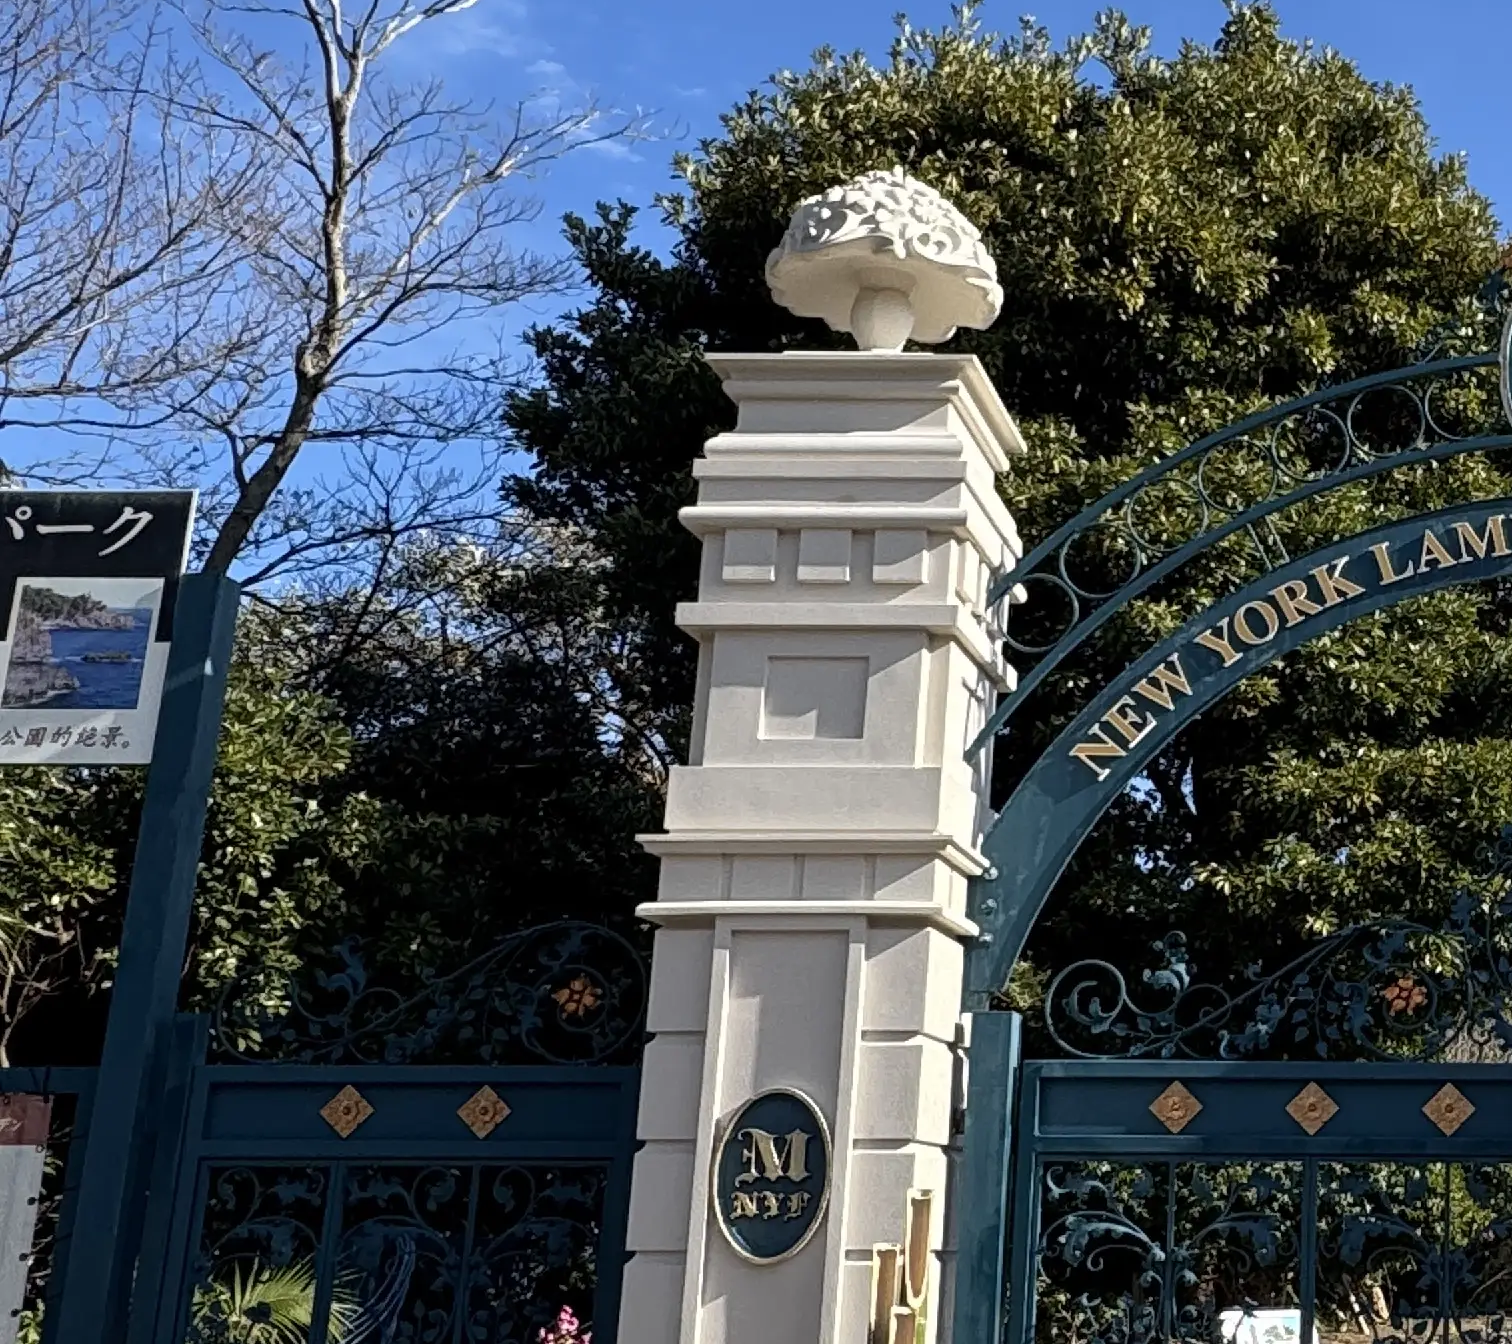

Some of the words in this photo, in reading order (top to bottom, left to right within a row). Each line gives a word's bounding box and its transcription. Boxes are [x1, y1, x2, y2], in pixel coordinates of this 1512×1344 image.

[1068, 653, 1194, 782] NEW
[1194, 555, 1366, 669] YORK
[735, 1128, 815, 1188] M
